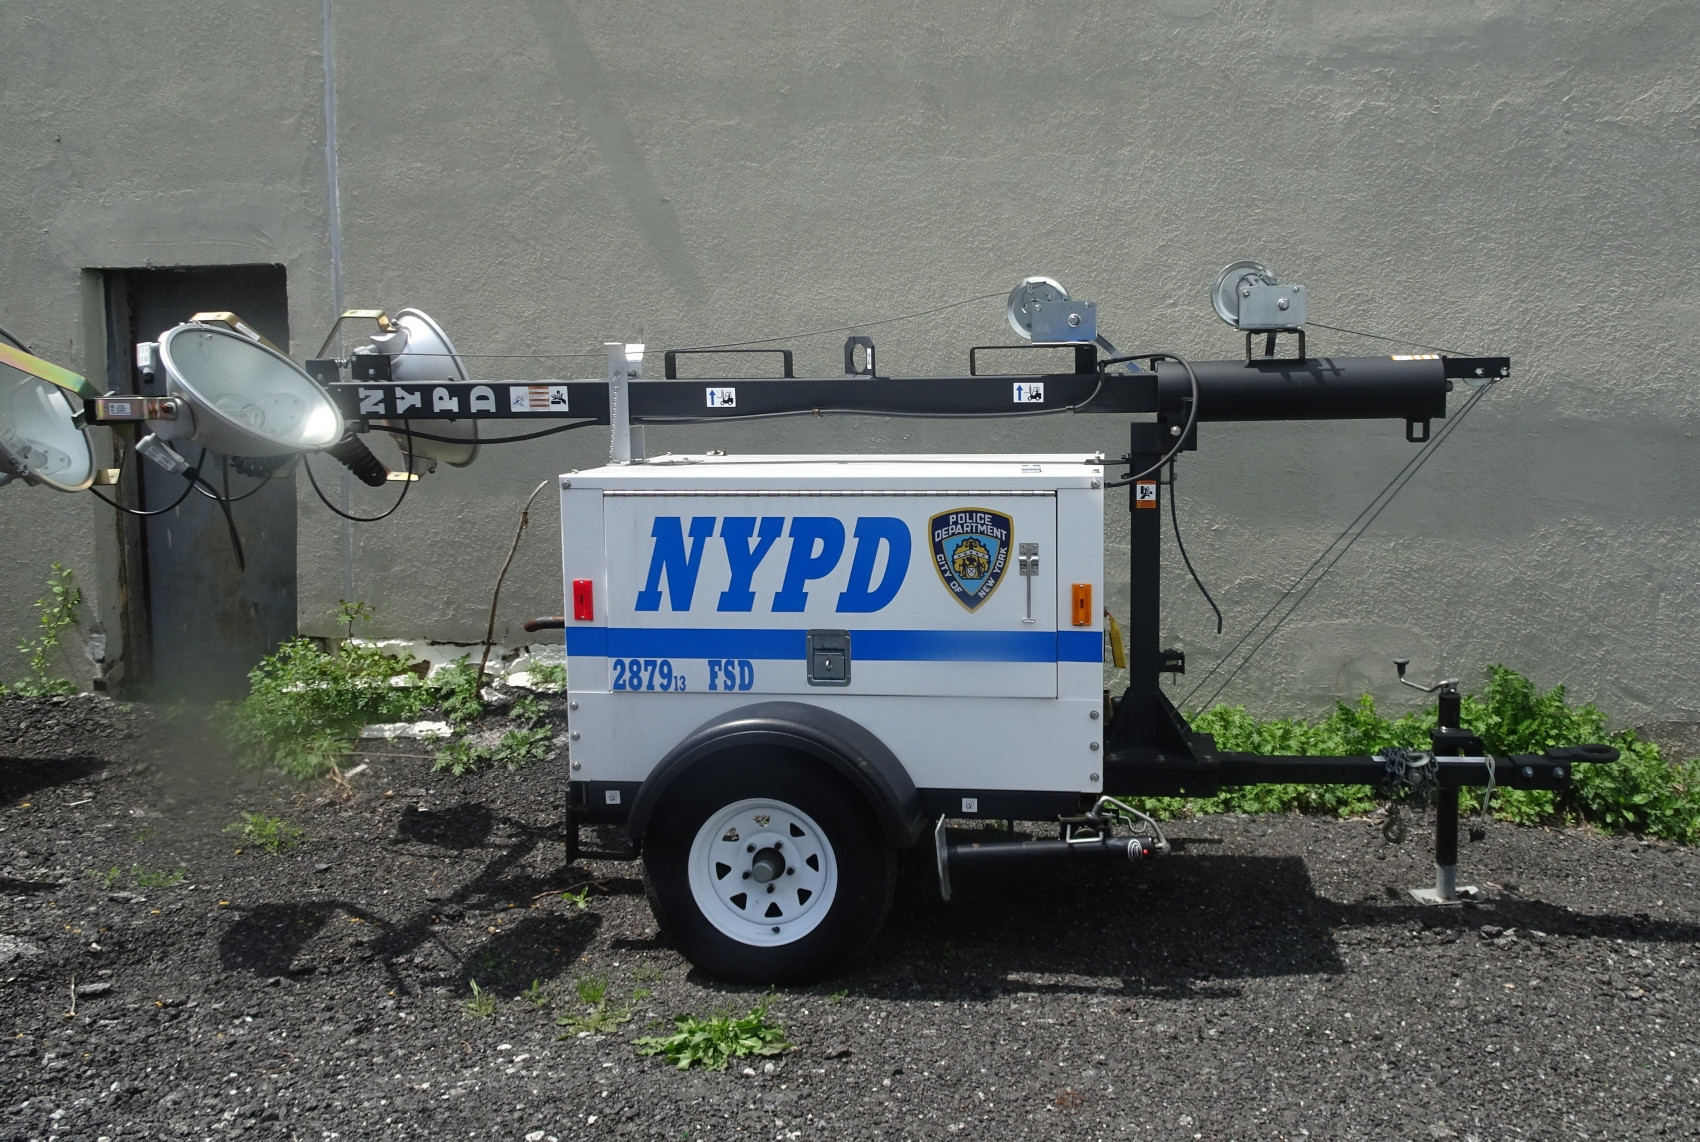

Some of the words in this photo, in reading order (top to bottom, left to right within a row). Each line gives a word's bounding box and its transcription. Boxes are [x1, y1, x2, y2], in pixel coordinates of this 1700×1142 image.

[358, 385, 496, 415] NYPD
[934, 523, 1007, 542] DEPARTMENT
[949, 513, 992, 526] POLICE
[634, 516, 912, 613] NYPD
[936, 553, 952, 579] CITY
[949, 580, 963, 594] OF
[977, 577, 996, 599] NEW
[993, 547, 1008, 574] YORK
[612, 658, 673, 691] 2879
[673, 675, 686, 692] 13
[707, 658, 755, 691] FSD
